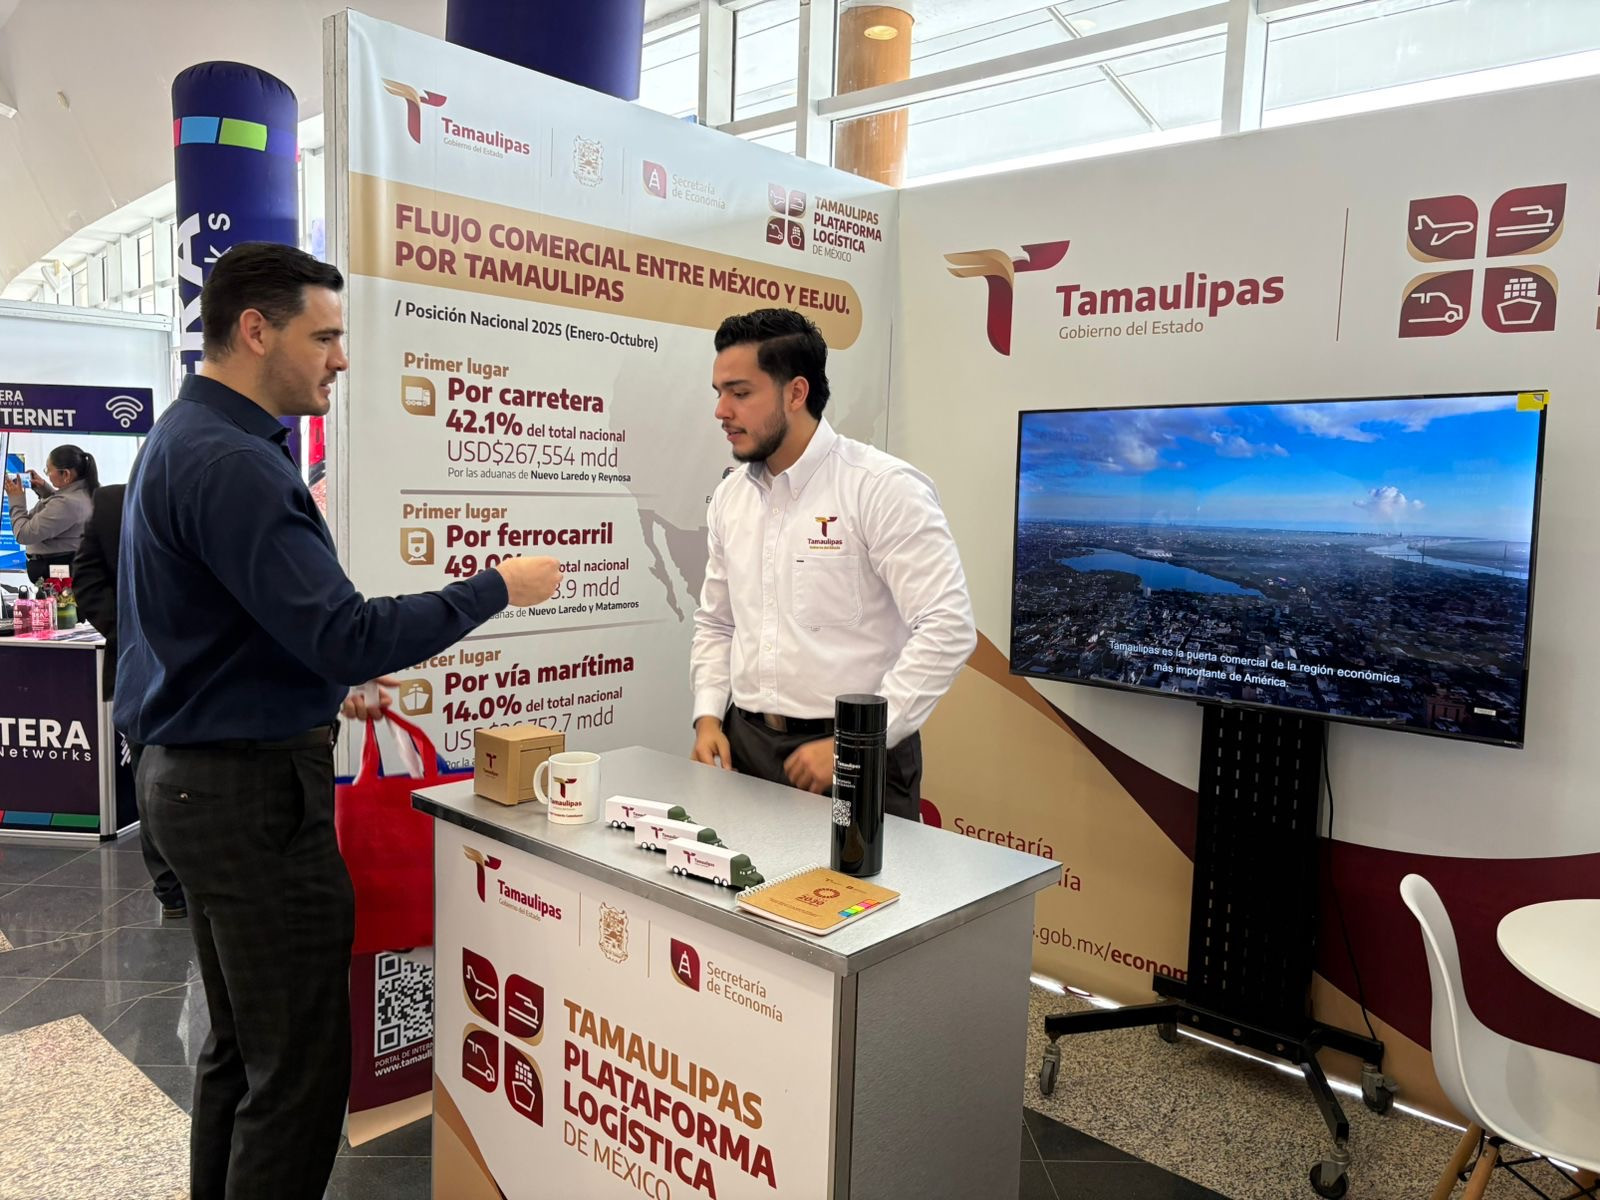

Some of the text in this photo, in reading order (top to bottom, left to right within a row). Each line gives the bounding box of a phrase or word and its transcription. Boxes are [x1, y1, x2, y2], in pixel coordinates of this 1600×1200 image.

[441, 117, 530, 155] Tamaulipas
[671, 174, 715, 196] Secretaría
[671, 187, 726, 210] de Economía
[815, 196, 879, 226] TAMAULIPAS
[813, 212, 882, 242] PLATAFORMA
[813, 225, 866, 253] LOGÍSTICA
[396, 203, 850, 315] FLUJO COMERCIAL ENTRE MÉXICO Y EE.UU.
[812, 245, 852, 263] DE MÉXICO
[395, 241, 625, 302] POR TAMAULIPAS
[1055, 271, 1285, 317] Tamaulipas
[405, 302, 467, 324] Posición
[470, 311, 529, 333] Nacional
[531, 320, 562, 336] 2025
[565, 324, 659, 352] (Enero-Octubre)
[1058, 319, 1204, 340] Gobierno del Estado
[404, 351, 510, 380] Primer lugar
[447, 377, 604, 413] Por carretera
[0, 408, 77, 427] TERNET
[445, 408, 626, 443] 42.1% del total nacional
[447, 439, 618, 468] USD$267,554 mdd
[447, 467, 631, 484] Por las aduanas de Nuevo Laredo y Reynosa
[402, 503, 508, 522] Primer lugar
[446, 521, 614, 548] Por ferrocarril
[808, 538, 843, 546] Tamaulipas
[558, 560, 581, 573] otal
[583, 558, 630, 572] nacional
[582, 576, 620, 597] mdd
[516, 608, 527, 618] de
[528, 607, 557, 617] Nuevo
[558, 603, 587, 615] Laredo
[588, 604, 594, 614] y
[595, 600, 640, 612] Matamoros
[459, 649, 502, 667] lugar
[1108, 640, 1401, 684] Tamaulipas es la puerta comercial de la región económica
[444, 653, 635, 696] Por vía marítima
[1153, 662, 1289, 689] más importante de América.
[442, 686, 623, 725] 14.0% del total nacional
[577, 704, 614, 731] mdd
[0, 717, 91, 750] TERA
[953, 817, 1054, 860] Secretaría
[497, 879, 562, 921] Tamaulipas
[706, 961, 767, 999] Secretaría
[706, 978, 783, 1023] de Economía
[563, 998, 763, 1130] TAMAULIPAS
[563, 1039, 778, 1190] PLATAFORMA
[563, 1080, 718, 1200] LOGÍSTICA
[563, 1119, 671, 1200] DE MÉXICO
